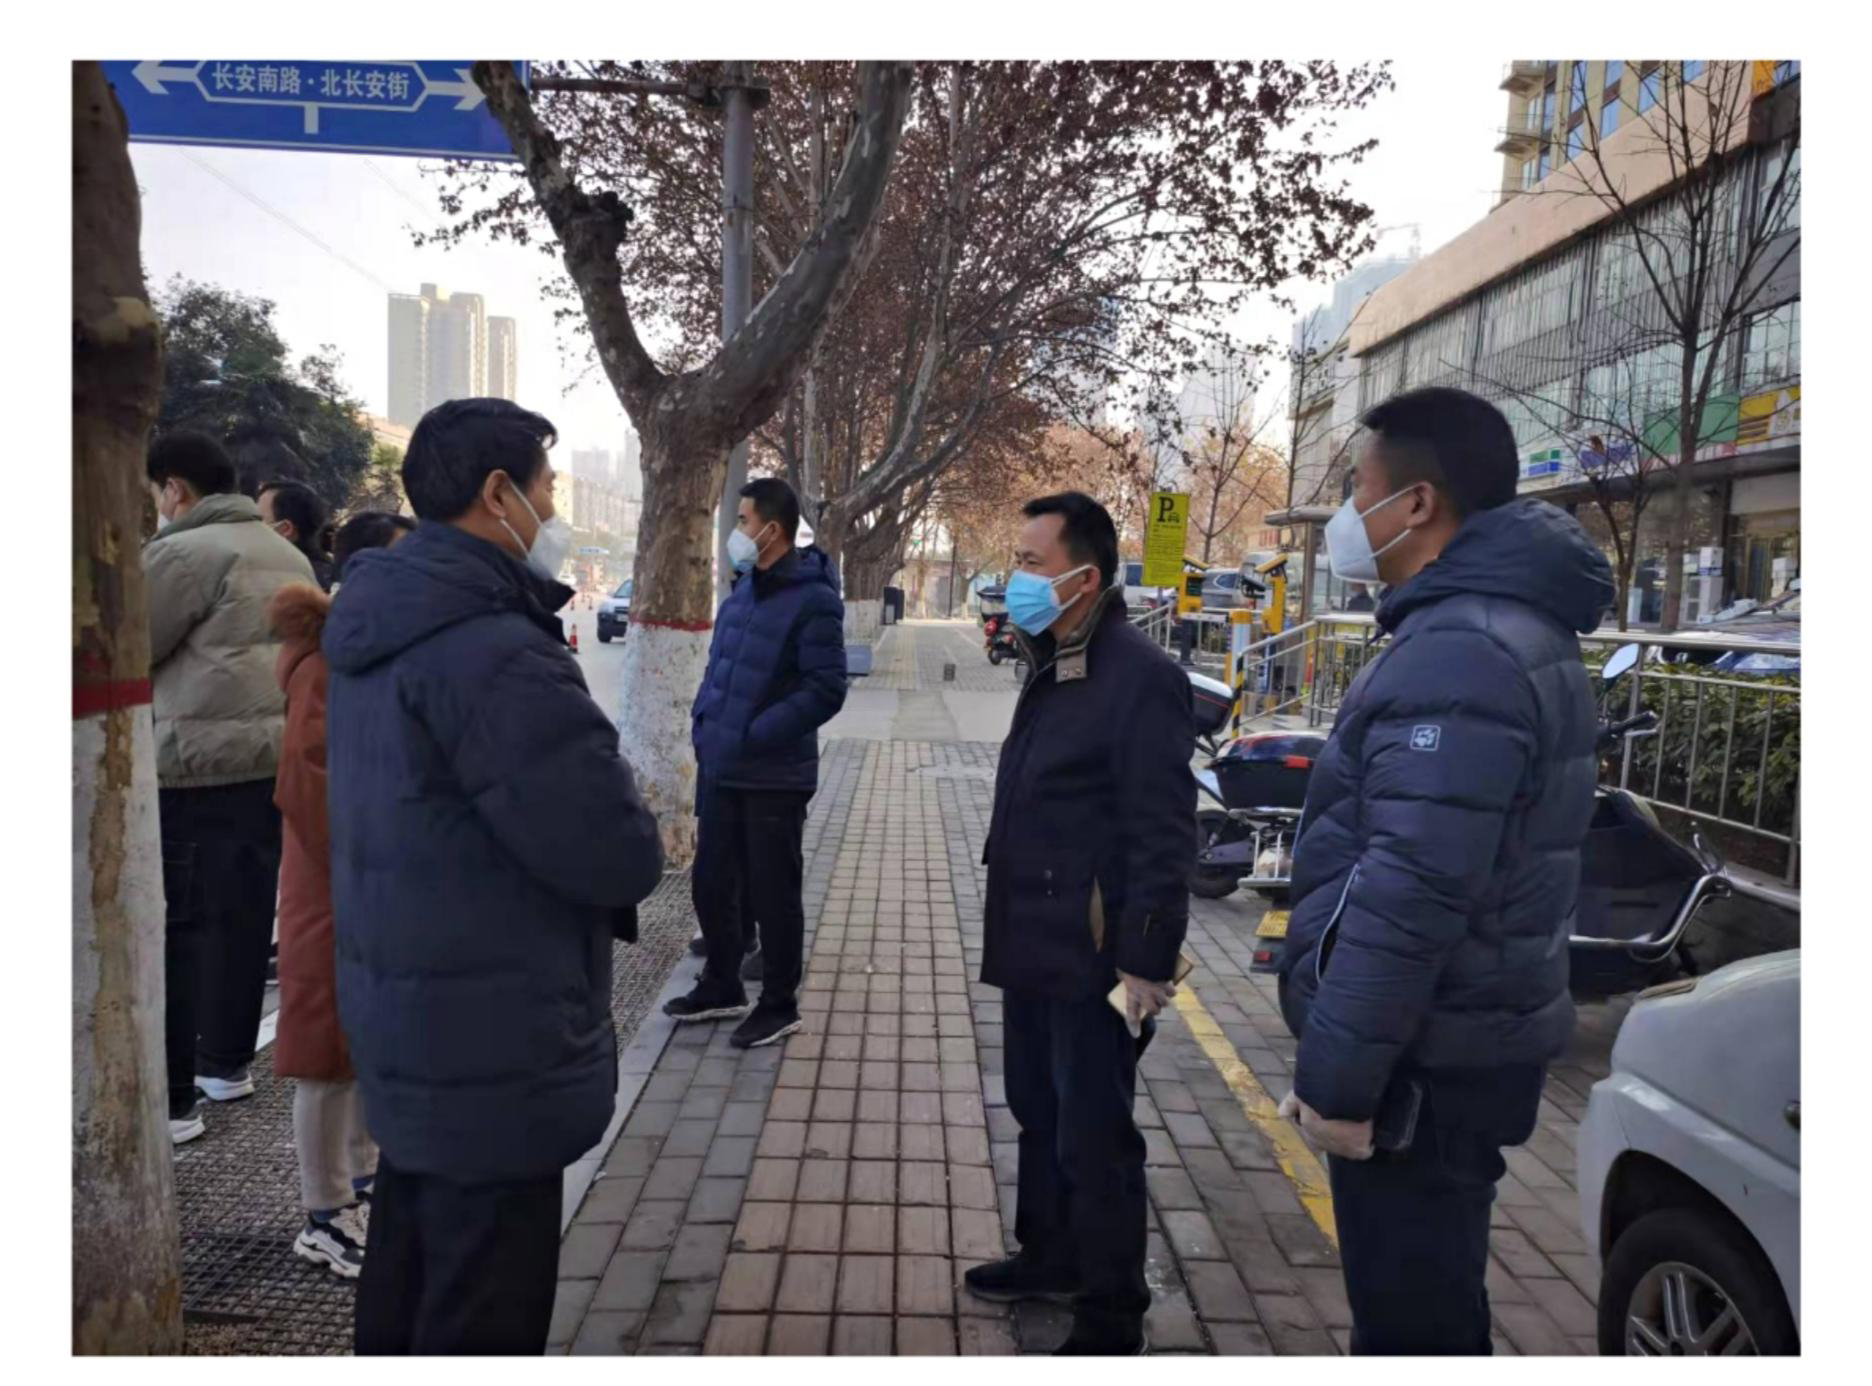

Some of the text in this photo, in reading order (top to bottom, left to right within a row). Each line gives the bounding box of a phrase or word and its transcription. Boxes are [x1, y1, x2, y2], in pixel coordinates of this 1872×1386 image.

[211, 61, 410, 100] 长安南路·北长安街
[1156, 496, 1175, 523] P
